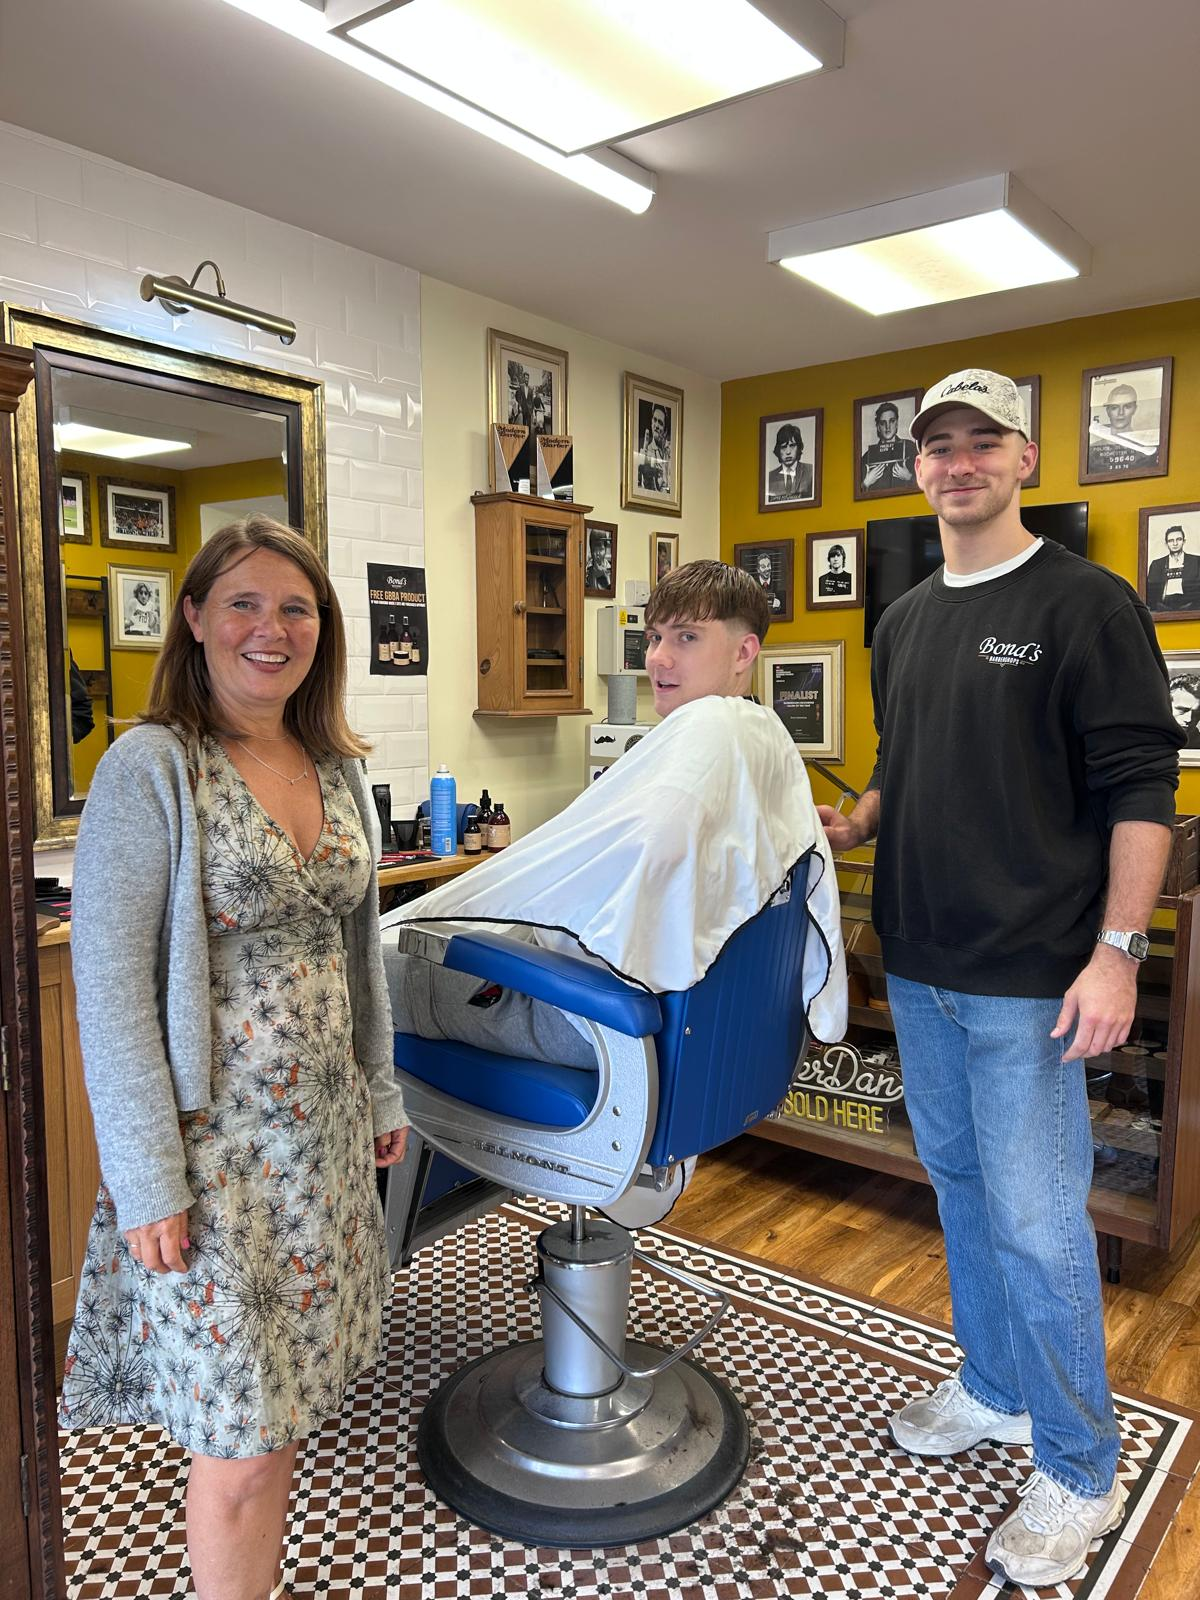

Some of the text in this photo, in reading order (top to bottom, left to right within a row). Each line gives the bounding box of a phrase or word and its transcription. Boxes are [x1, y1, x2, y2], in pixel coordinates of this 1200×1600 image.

[370, 590, 384, 600] FREE
[400, 592, 425, 603] PRODUCT
[979, 637, 1043, 662] Bond's
[780, 691, 819, 700] FINALIST
[783, 1091, 829, 1122] SOLD
[833, 1098, 884, 1134] HERE
